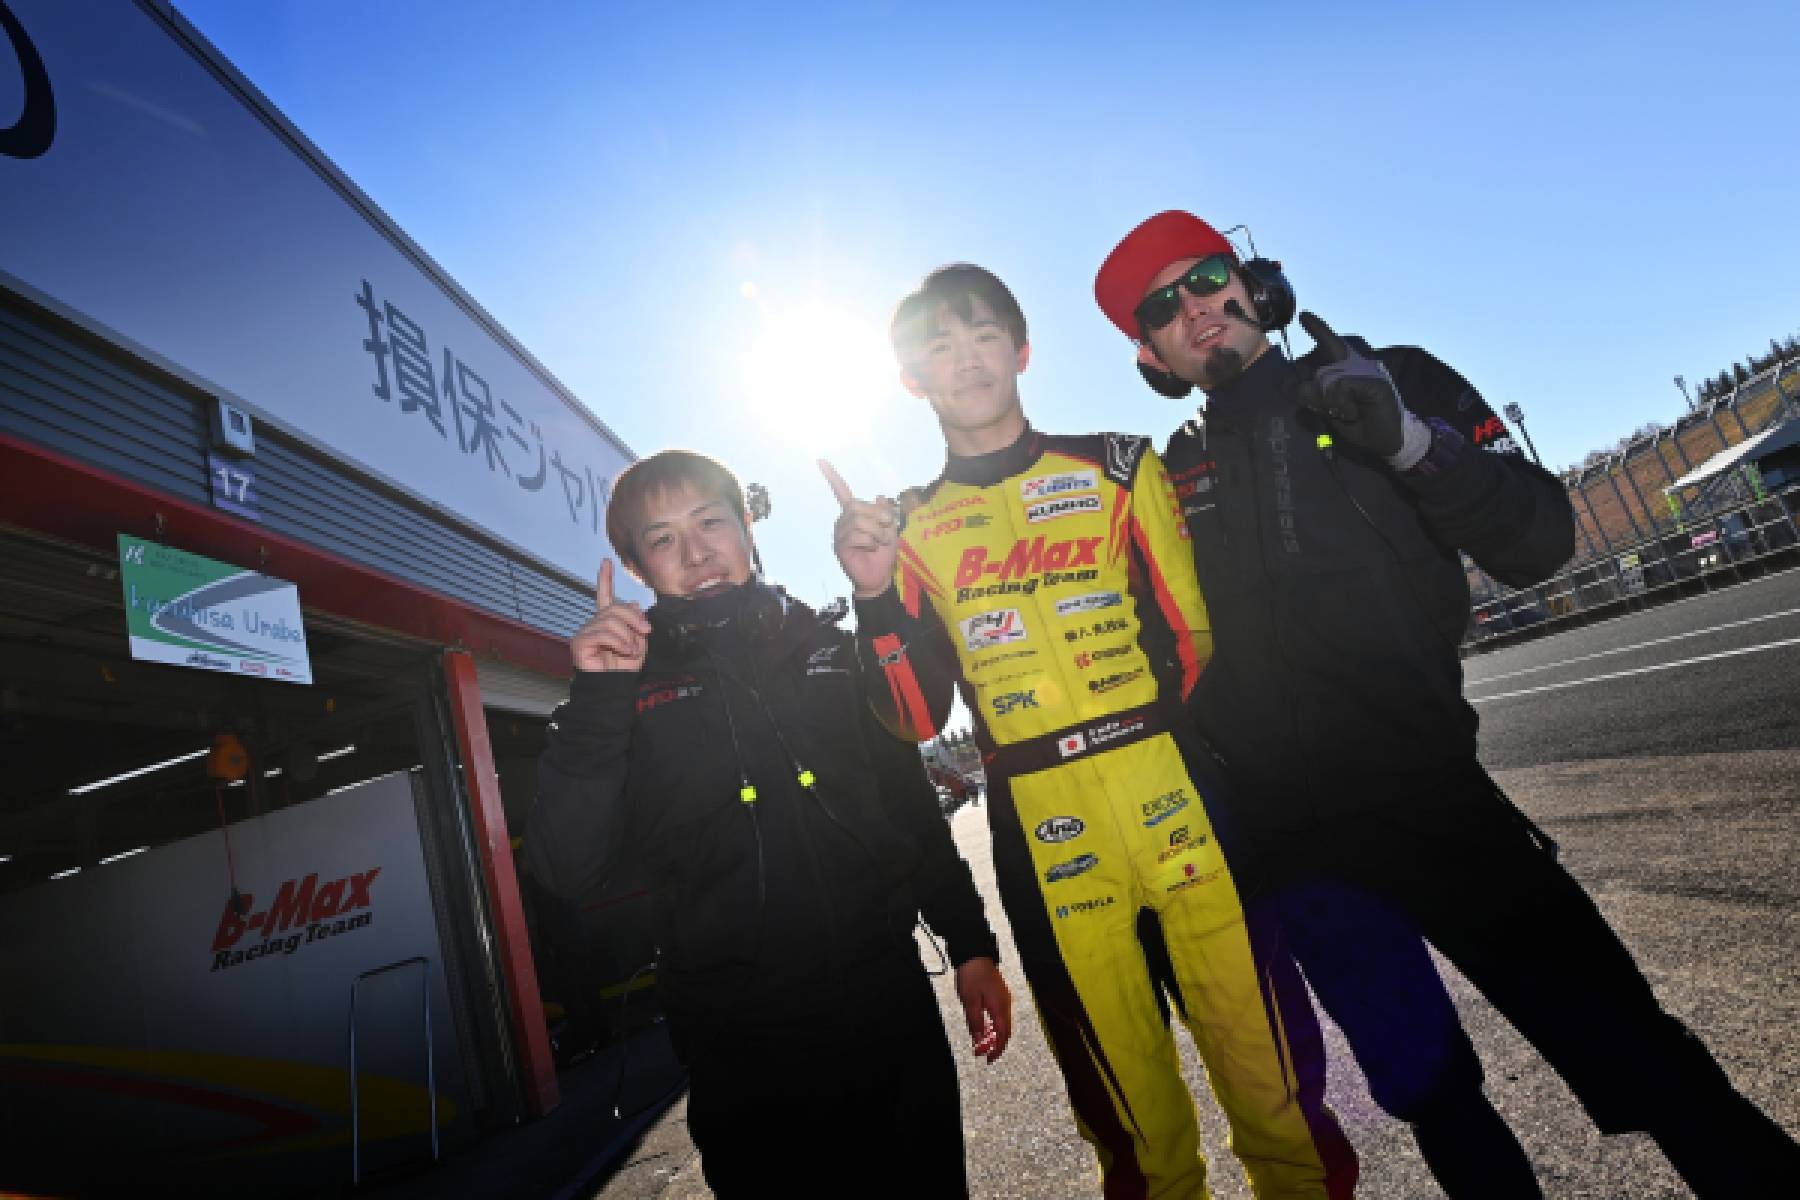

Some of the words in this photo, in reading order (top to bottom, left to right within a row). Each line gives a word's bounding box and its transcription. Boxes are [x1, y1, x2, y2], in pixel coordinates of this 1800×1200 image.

[217, 466, 251, 504] 17
[954, 534, 1105, 588] B-Max
[956, 578, 1039, 605] Racing
[1044, 569, 1099, 587] Team
[992, 689, 1040, 717] SPK
[210, 867, 382, 954] B-Max
[210, 933, 303, 972] Racing
[305, 911, 373, 943] Team
